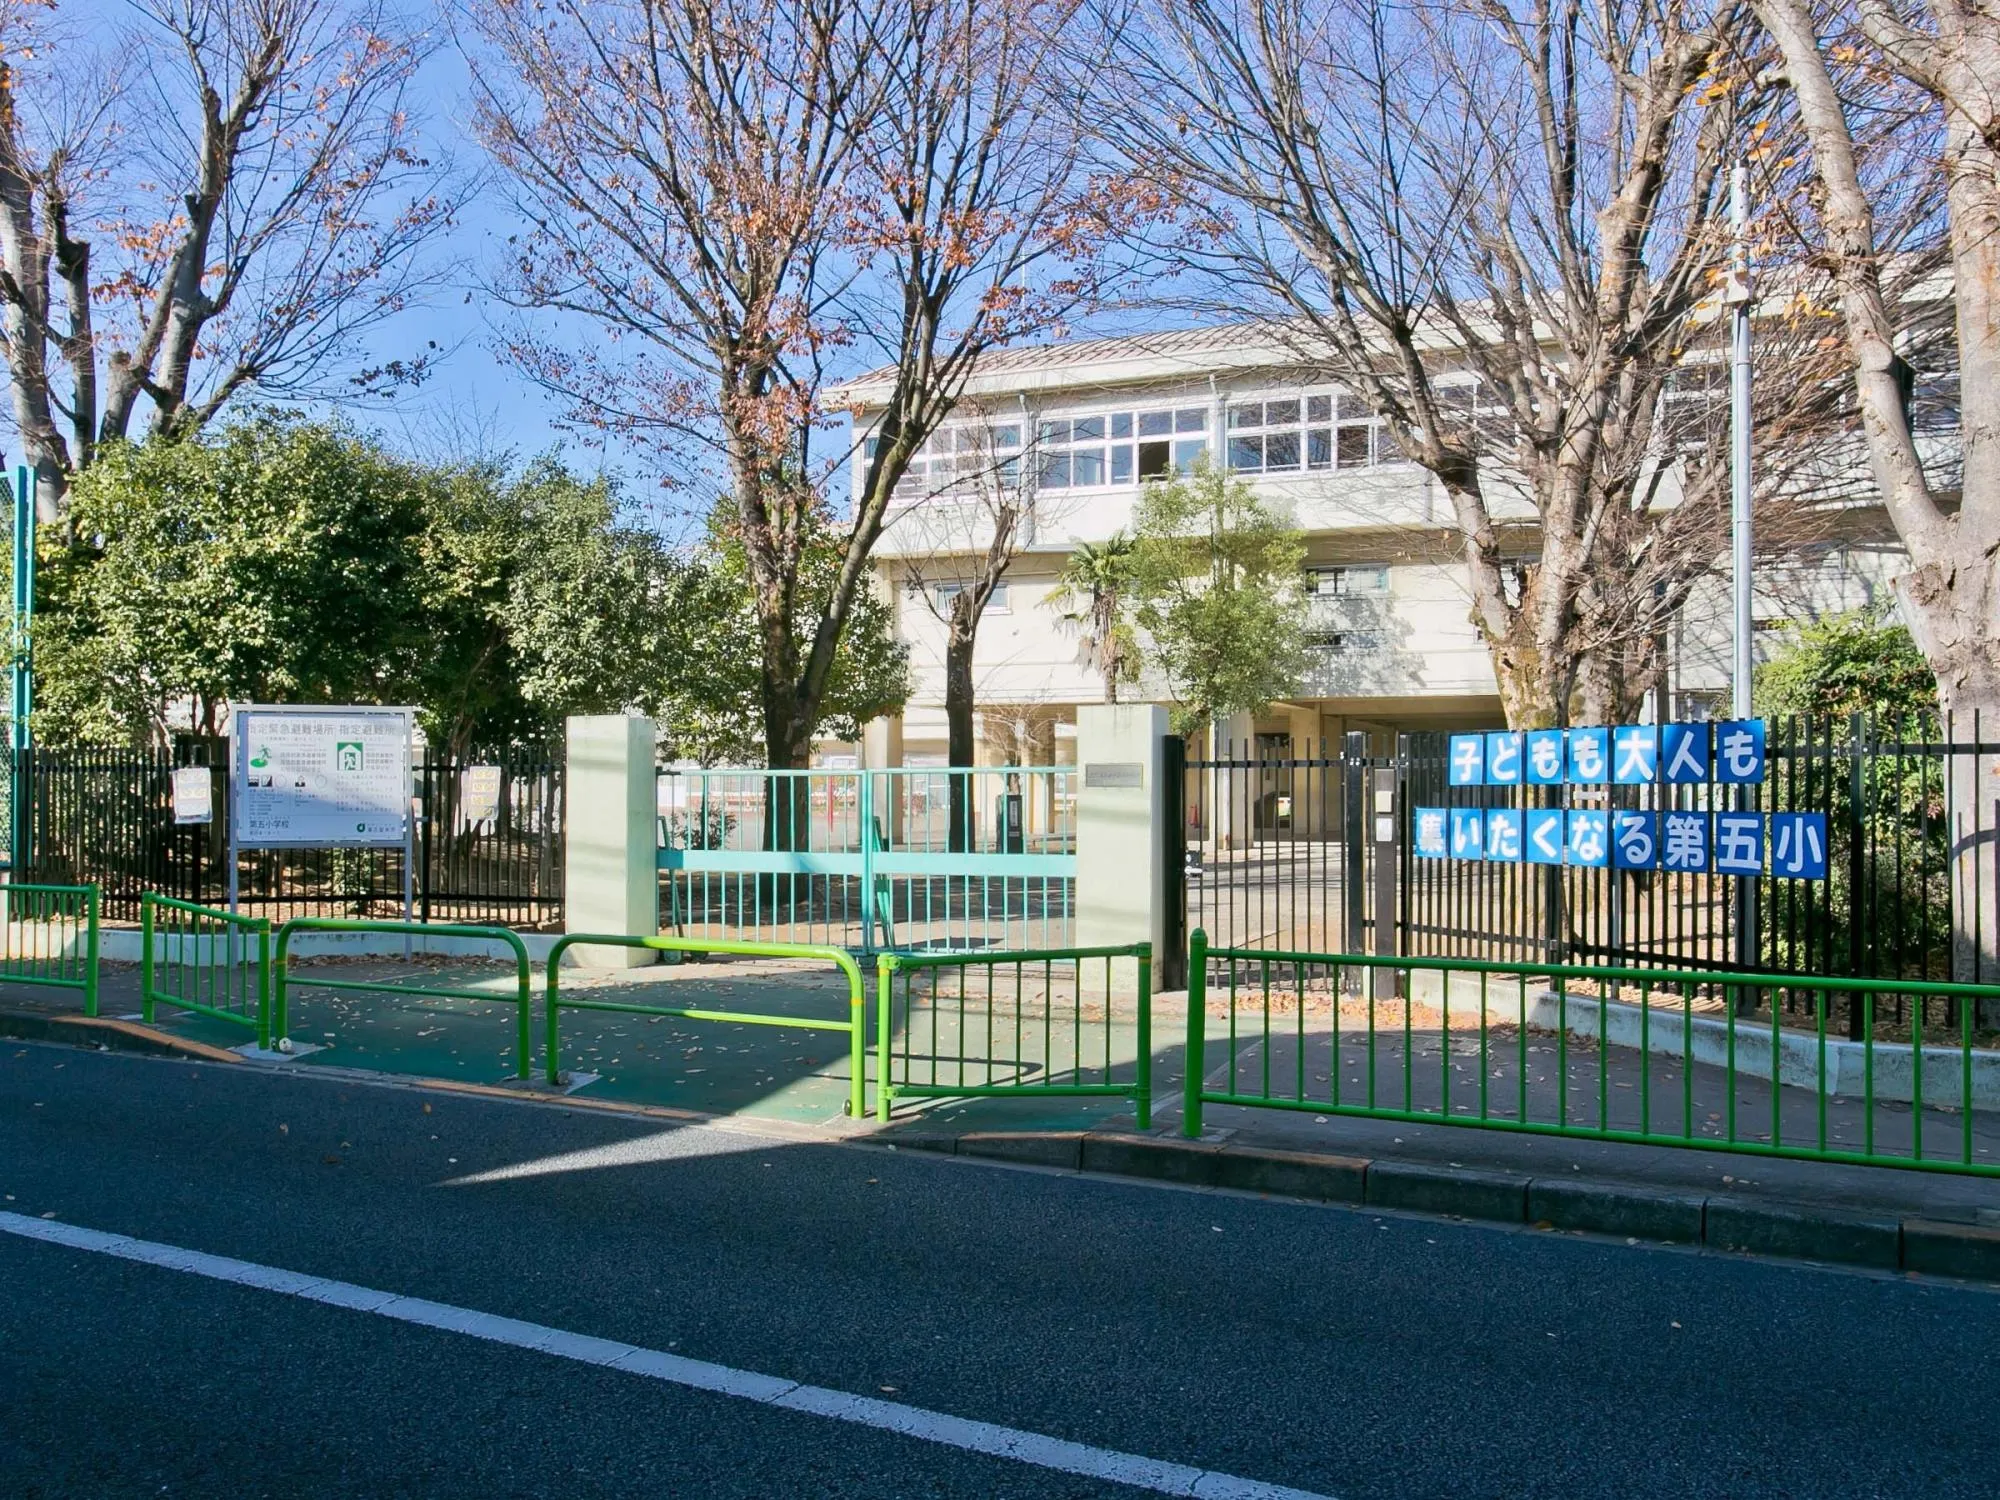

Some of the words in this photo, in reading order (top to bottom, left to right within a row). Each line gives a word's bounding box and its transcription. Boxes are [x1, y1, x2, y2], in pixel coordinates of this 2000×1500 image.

[1452, 729, 1760, 781] 子どもも大人も
[249, 819, 289, 829] 第五小学校
[1418, 815, 1823, 874] 集いたくなる第五小
